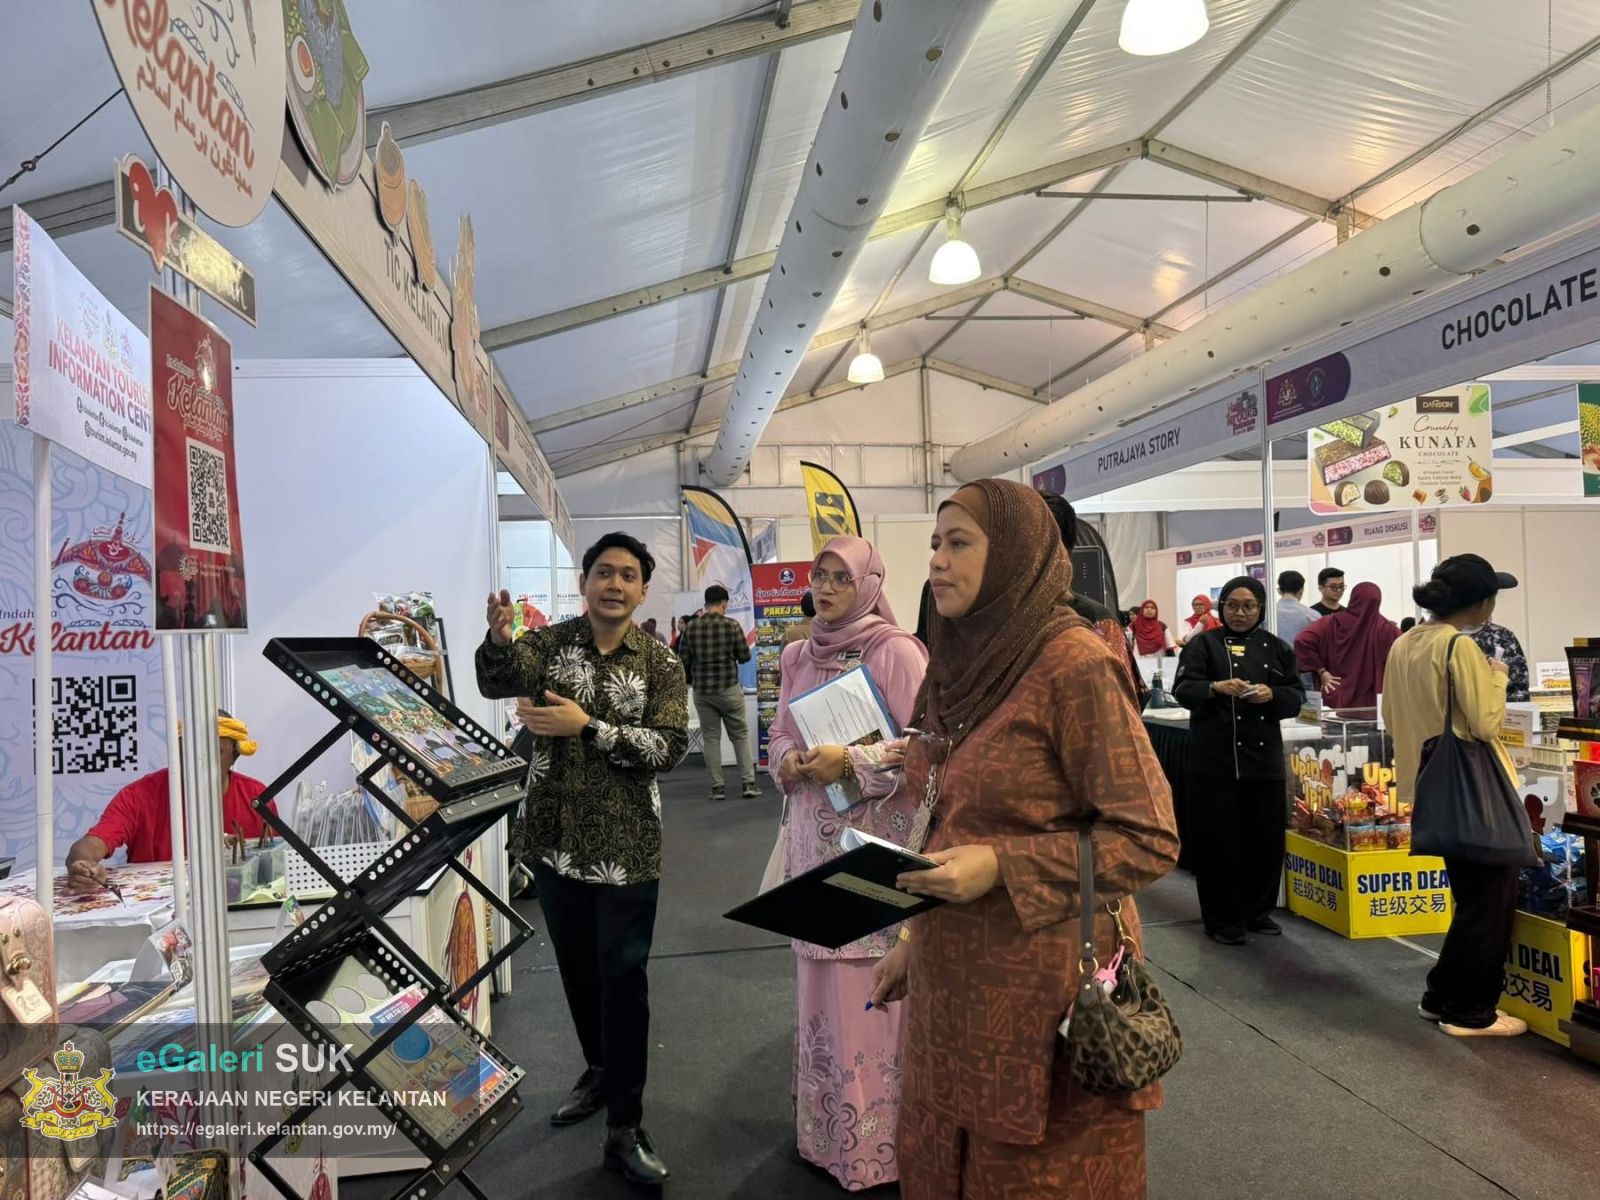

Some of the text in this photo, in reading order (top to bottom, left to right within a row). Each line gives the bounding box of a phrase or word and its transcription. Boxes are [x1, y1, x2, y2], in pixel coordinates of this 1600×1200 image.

[402, 270, 450, 356] KELANTAN
[1441, 267, 1598, 351] CHOCOLATE
[57, 318, 110, 383] KELANTAN
[48, 341, 125, 417] INFORMATION
[1399, 436, 1477, 449] KUNAFA
[1414, 414, 1459, 436] Crunchy
[1098, 427, 1181, 472] PUTRAJAYA STORY
[1364, 522, 1408, 536] RUANG DISKUSI
[763, 606, 791, 617] PAKEJ
[1286, 851, 1344, 891] SUPER DEAL
[1357, 869, 1450, 894] SUPER DEA
[1369, 893, 1446, 917] 起级交易
[1518, 943, 1564, 982] DEAL
